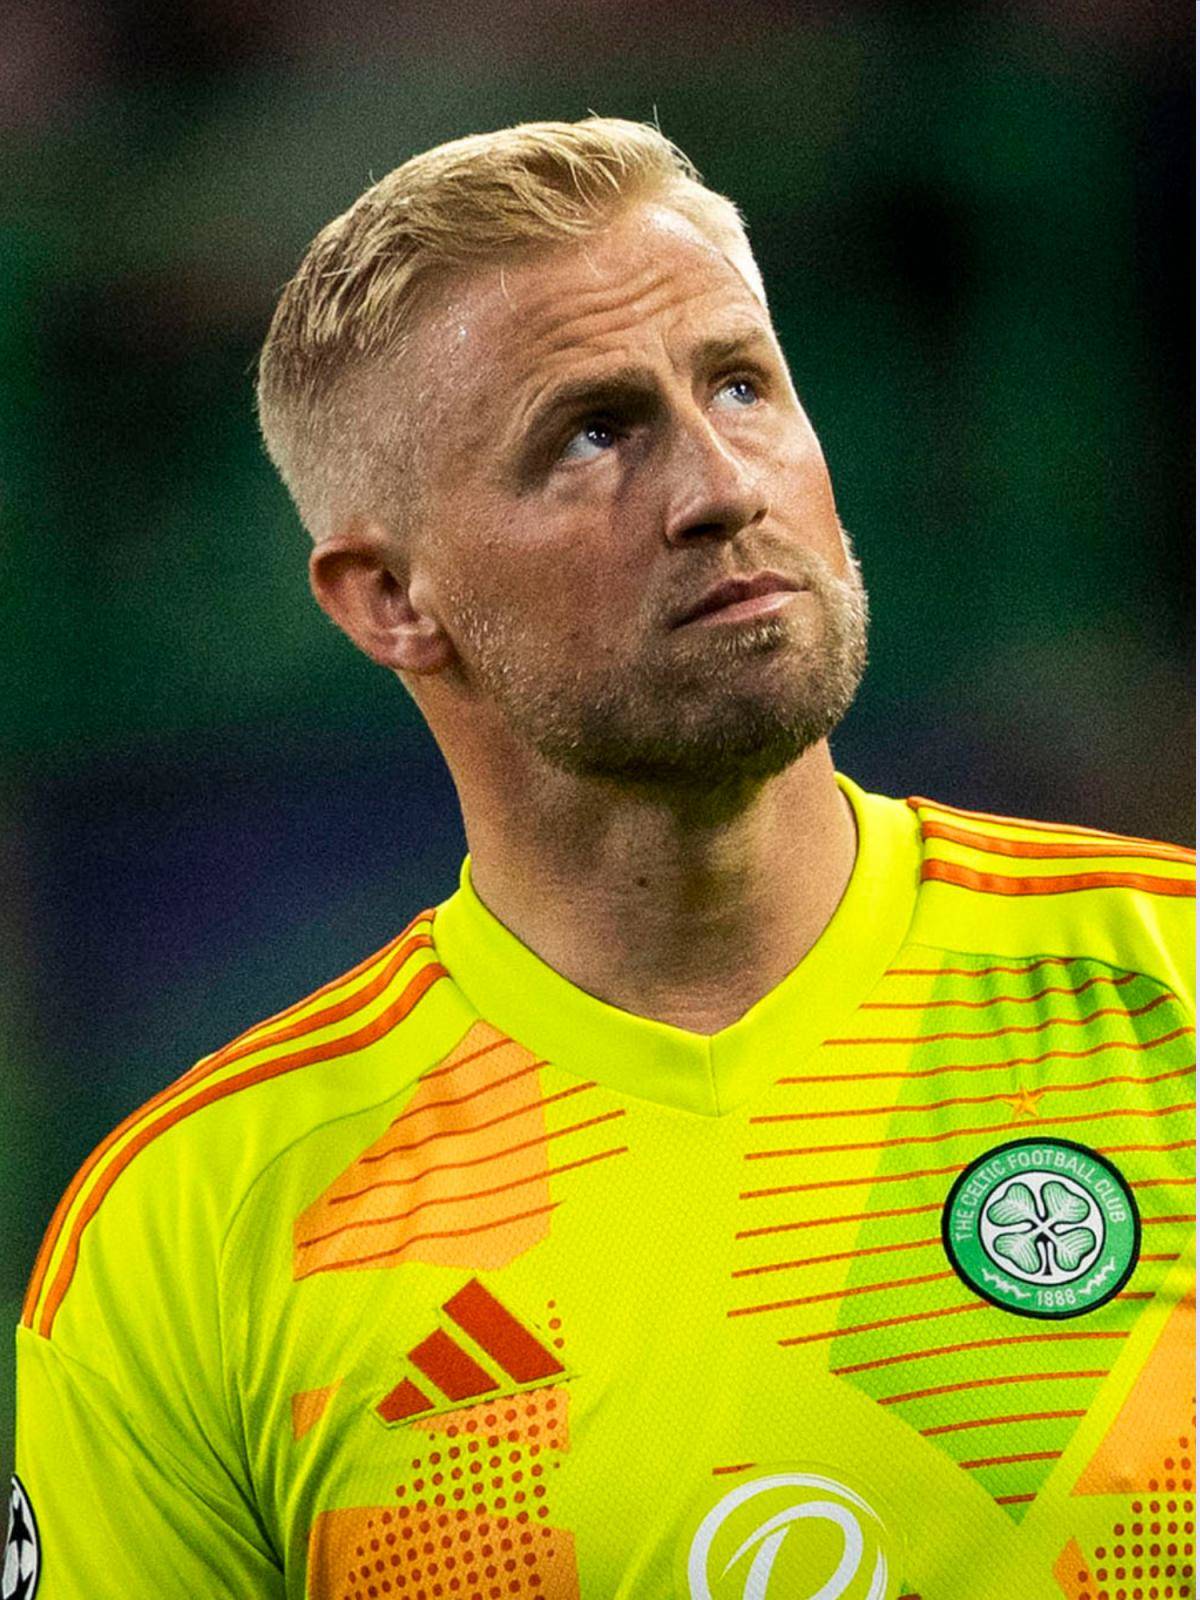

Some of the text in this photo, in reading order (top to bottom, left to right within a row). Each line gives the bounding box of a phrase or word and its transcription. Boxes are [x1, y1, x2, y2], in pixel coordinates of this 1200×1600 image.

[955, 1149, 1126, 1241] THE CELTIC FOOTBALL CLUB
[1035, 1288, 1077, 1307] 1888
